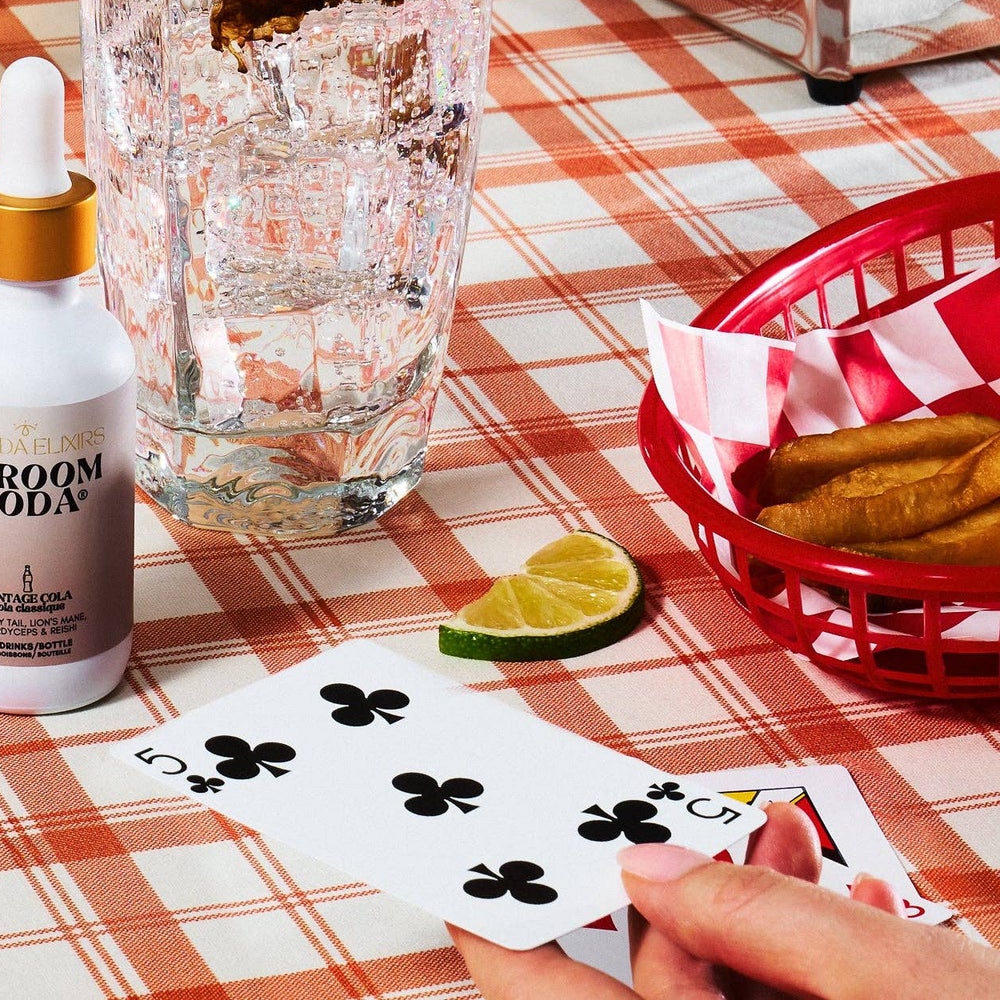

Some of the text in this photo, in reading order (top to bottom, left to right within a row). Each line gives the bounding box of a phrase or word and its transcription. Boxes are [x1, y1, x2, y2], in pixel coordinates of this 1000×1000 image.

[33, 426, 105, 456] ELIXIRS
[40, 590, 73, 603] COLA
[15, 602, 66, 614] classique
[7, 618, 27, 628] TAIL,
[30, 617, 58, 627] LION'S
[60, 612, 87, 624] MANE,
[50, 624, 77, 635] REISHI
[0, 638, 73, 652] DRINKS/BOTTLE
[134, 747, 188, 775] 5
[686, 798, 742, 824] 5
